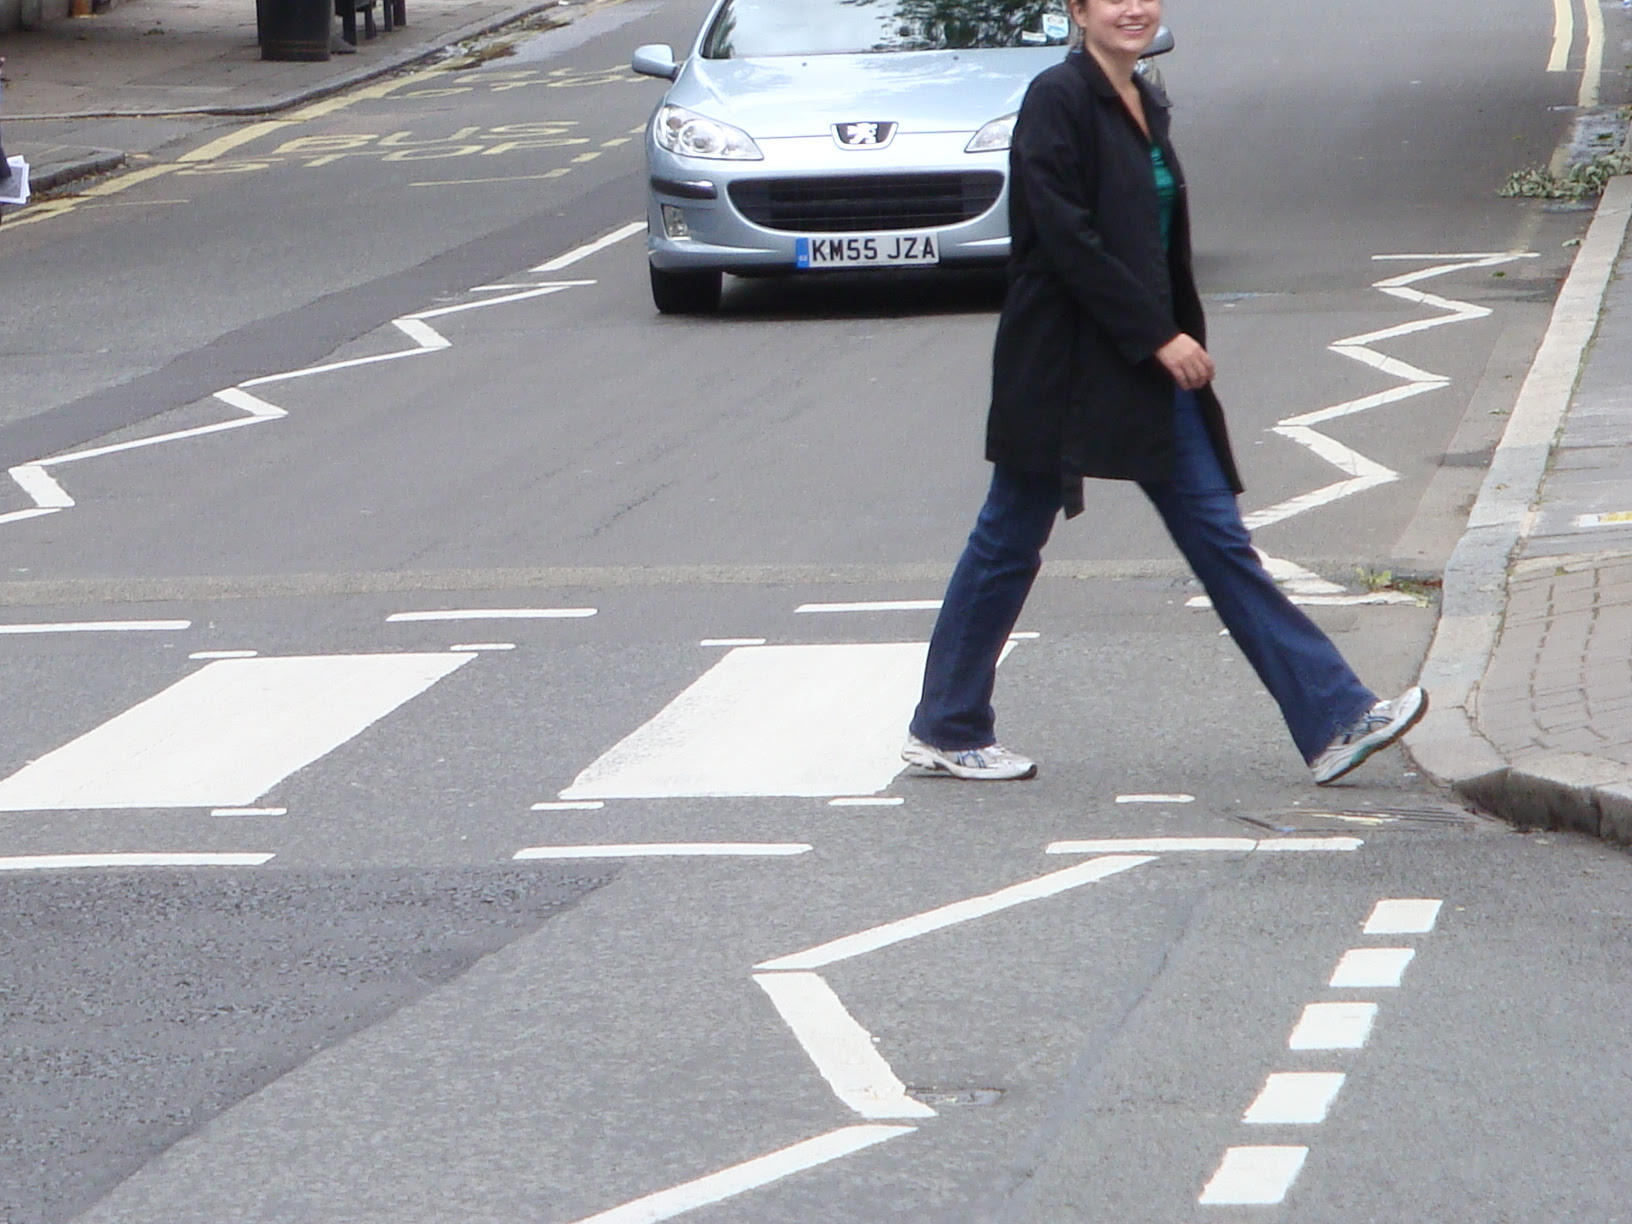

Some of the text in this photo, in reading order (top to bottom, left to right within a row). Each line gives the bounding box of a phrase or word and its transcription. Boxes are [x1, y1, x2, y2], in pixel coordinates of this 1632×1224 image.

[271, 120, 580, 154] BUS
[174, 136, 592, 176] STOP
[812, 236, 936, 262] KM55 JZA
